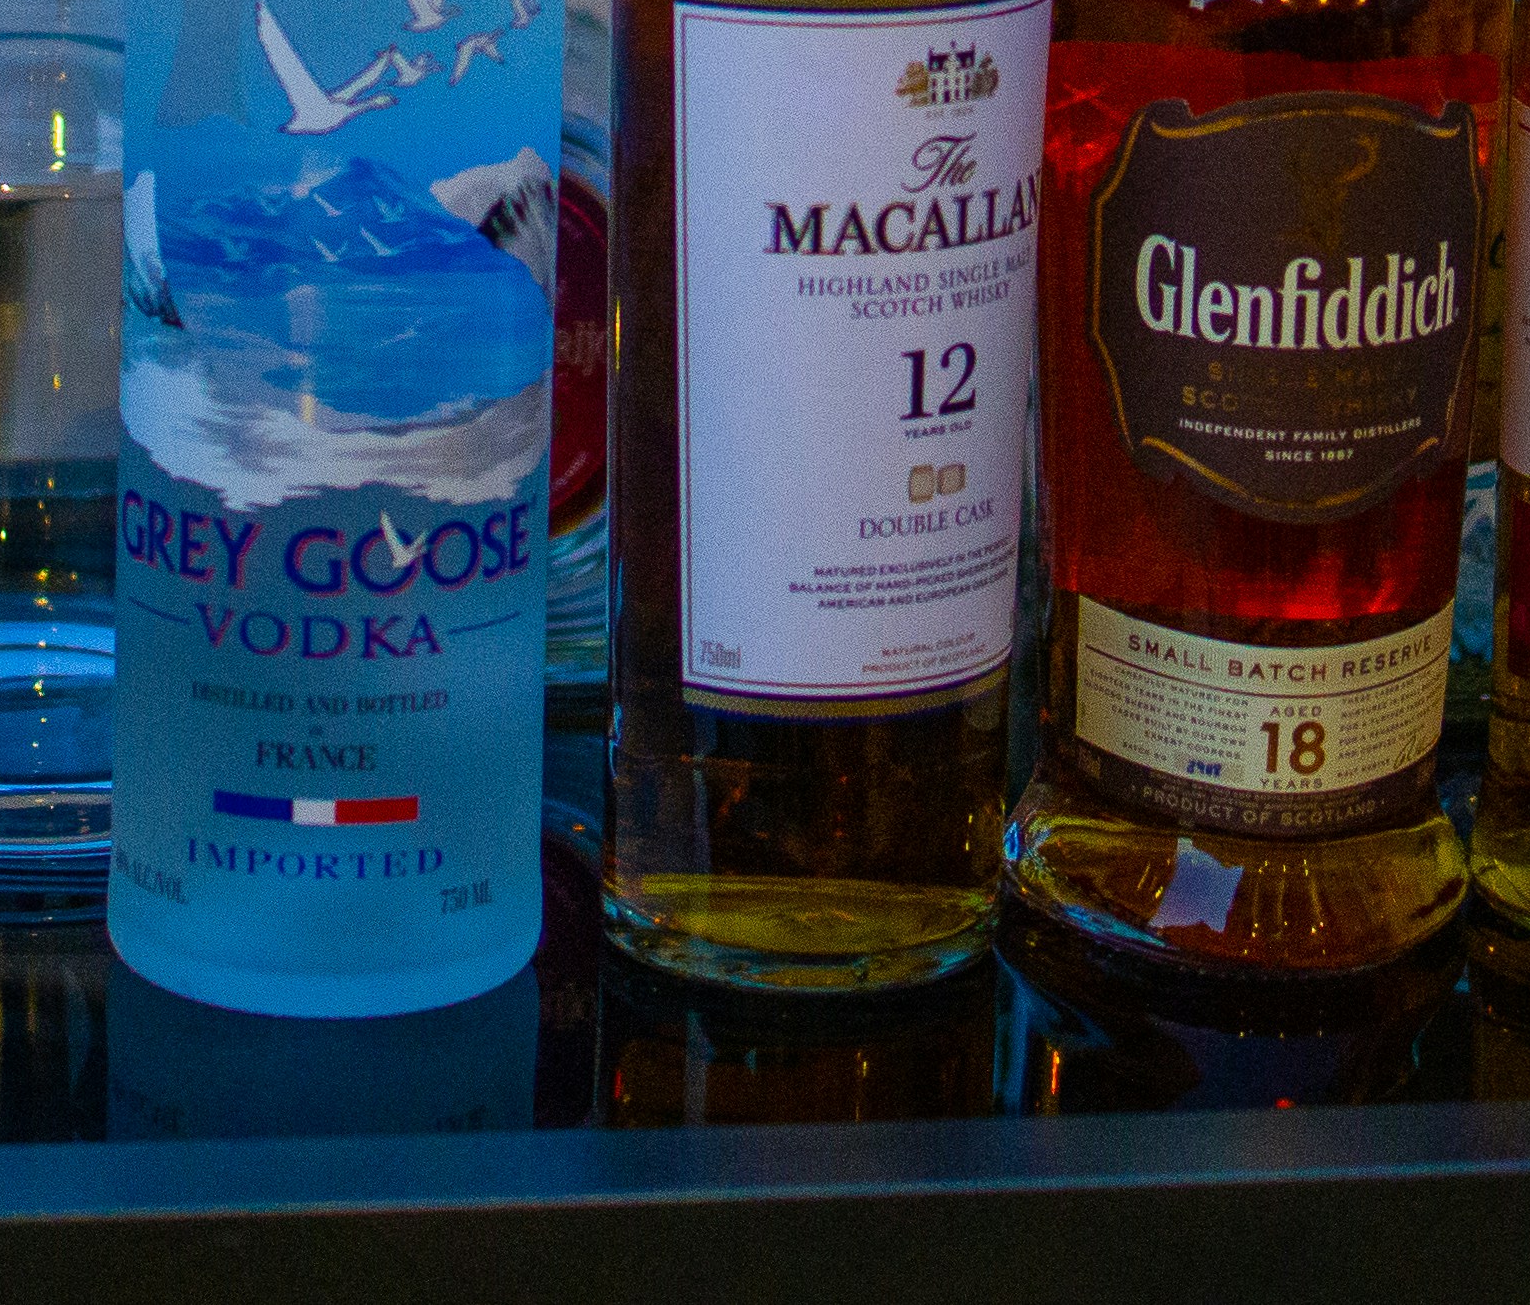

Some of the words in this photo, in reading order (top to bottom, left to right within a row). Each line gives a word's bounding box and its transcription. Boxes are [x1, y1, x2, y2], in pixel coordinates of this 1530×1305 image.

[901, 131, 977, 193] The
[798, 273, 931, 297] HIGHLAND
[938, 258, 1000, 290] SINGLE
[1135, 233, 1457, 351] Glenfiddich
[851, 294, 944, 320] SCOTCH
[951, 278, 1011, 310] WHISKY
[900, 342, 977, 420] 12
[905, 423, 946, 439] YEARS
[950, 421, 972, 434] OLD
[1179, 418, 1286, 441] INDEPENDENT
[1293, 430, 1347, 442] FAMILY
[1353, 415, 1422, 439] DISTILLERS
[1265, 449, 1314, 462] SINCE
[859, 510, 949, 540] DOUBLE
[955, 498, 995, 530] CASK
[122, 490, 263, 590] GREY
[283, 503, 532, 598] GOOSE
[789, 581, 851, 593] BALANCE
[814, 566, 877, 579] MATURED
[819, 597, 886, 609] AMERICAN
[889, 594, 913, 606] AND
[916, 585, 970, 604] EUROPEAN
[195, 602, 444, 660] VODKA
[1128, 633, 1212, 673] SMALL
[1229, 660, 1327, 683] BATCH
[1341, 634, 1433, 680] RESERVE
[1270, 705, 1323, 719] AGED
[257, 742, 377, 771] FRANCE
[1260, 720, 1326, 776] 18
[1259, 778, 1324, 790] YEARS
[1142, 785, 1234, 821] PRODUCT
[1242, 807, 1276, 827] OF
[1279, 800, 1376, 827] SCOTLAND
[189, 838, 445, 880] IMPORTED
